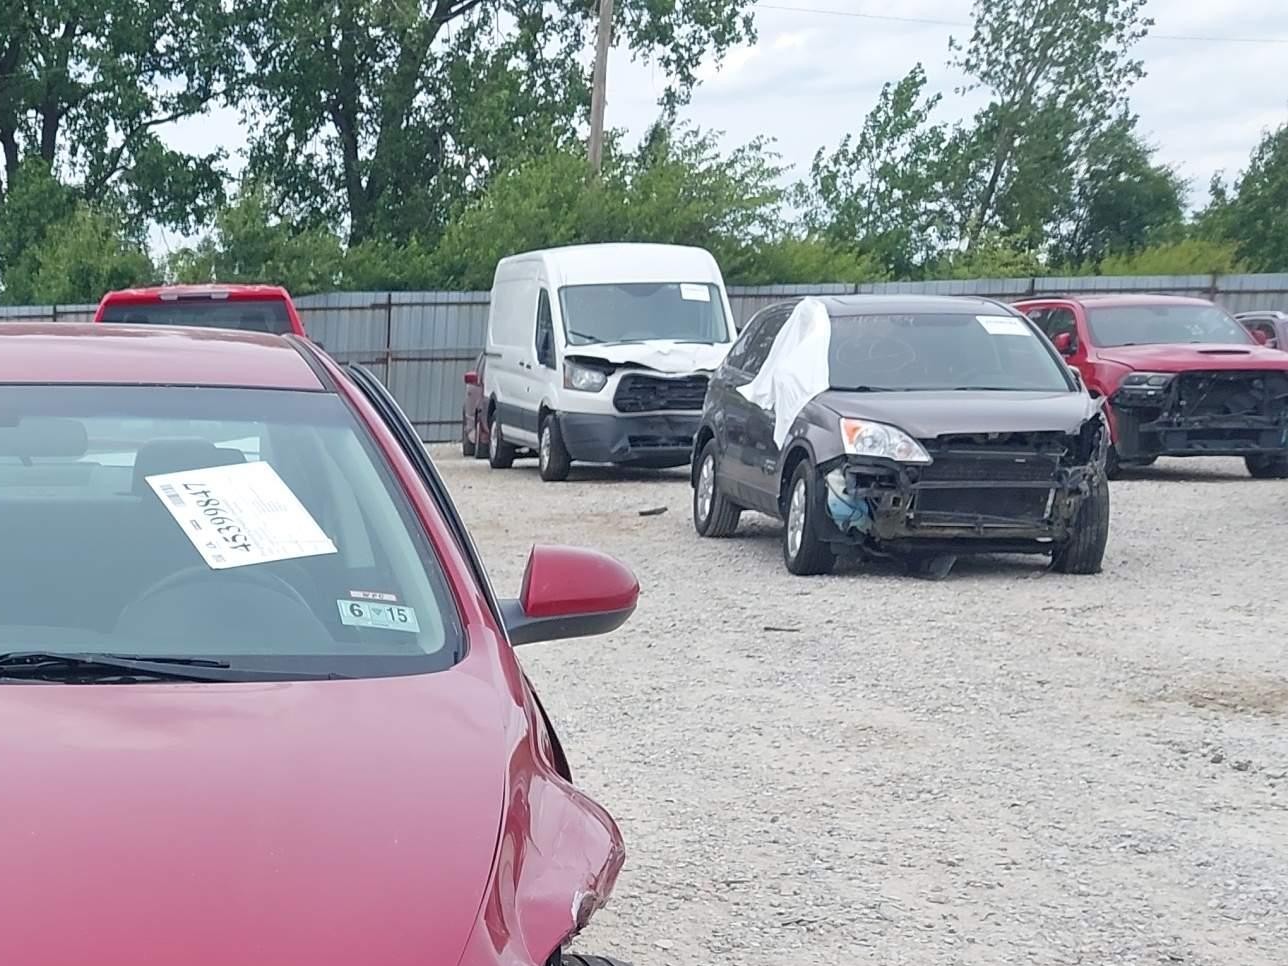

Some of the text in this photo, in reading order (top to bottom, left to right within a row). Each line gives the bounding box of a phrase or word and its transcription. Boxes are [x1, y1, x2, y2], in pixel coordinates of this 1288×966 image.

[182, 482, 253, 553] 45399847
[349, 603, 408, 623] 6 15
